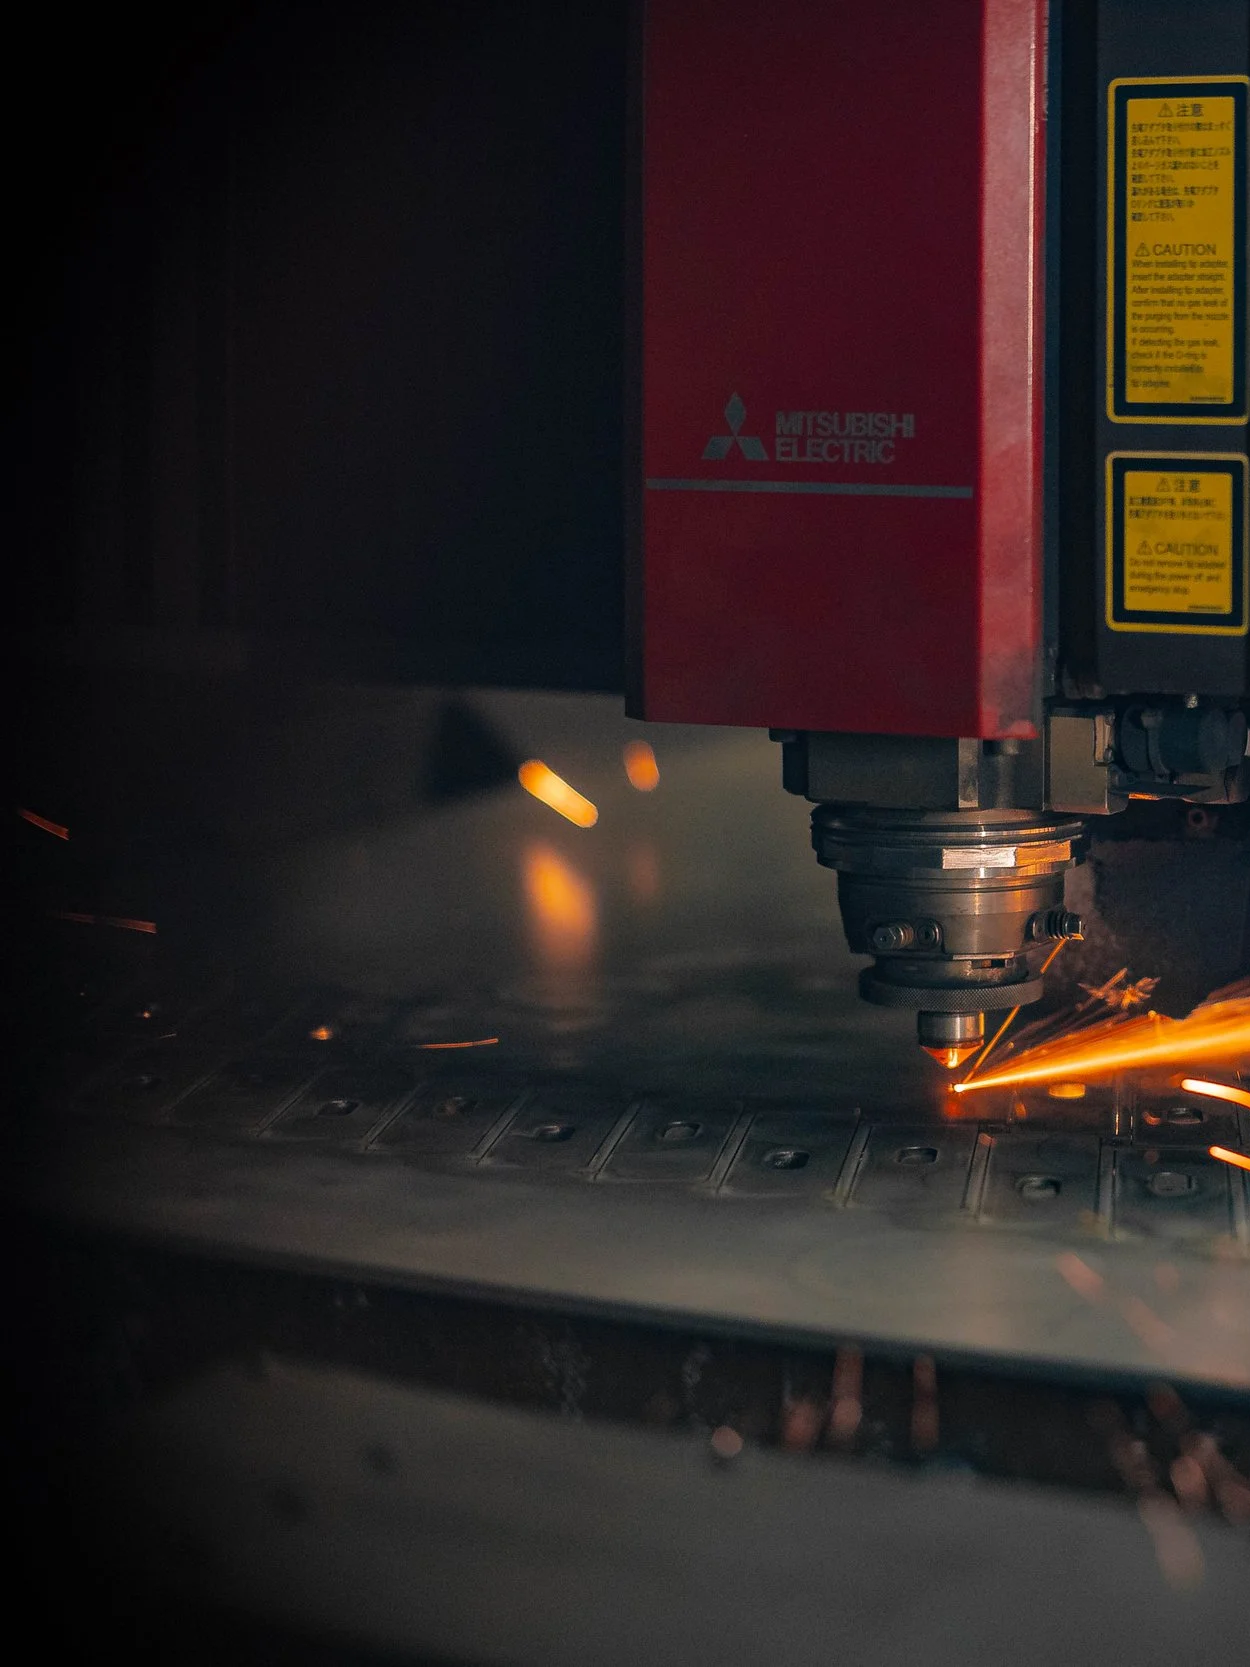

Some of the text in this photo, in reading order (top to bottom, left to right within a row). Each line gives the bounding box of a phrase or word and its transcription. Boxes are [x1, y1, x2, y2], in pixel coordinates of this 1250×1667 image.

[1153, 243, 1217, 256] CAUTION
[776, 411, 916, 438] MITSUBISHI
[776, 437, 896, 464] ELECTRIC
[1155, 543, 1219, 556] CAUTION
